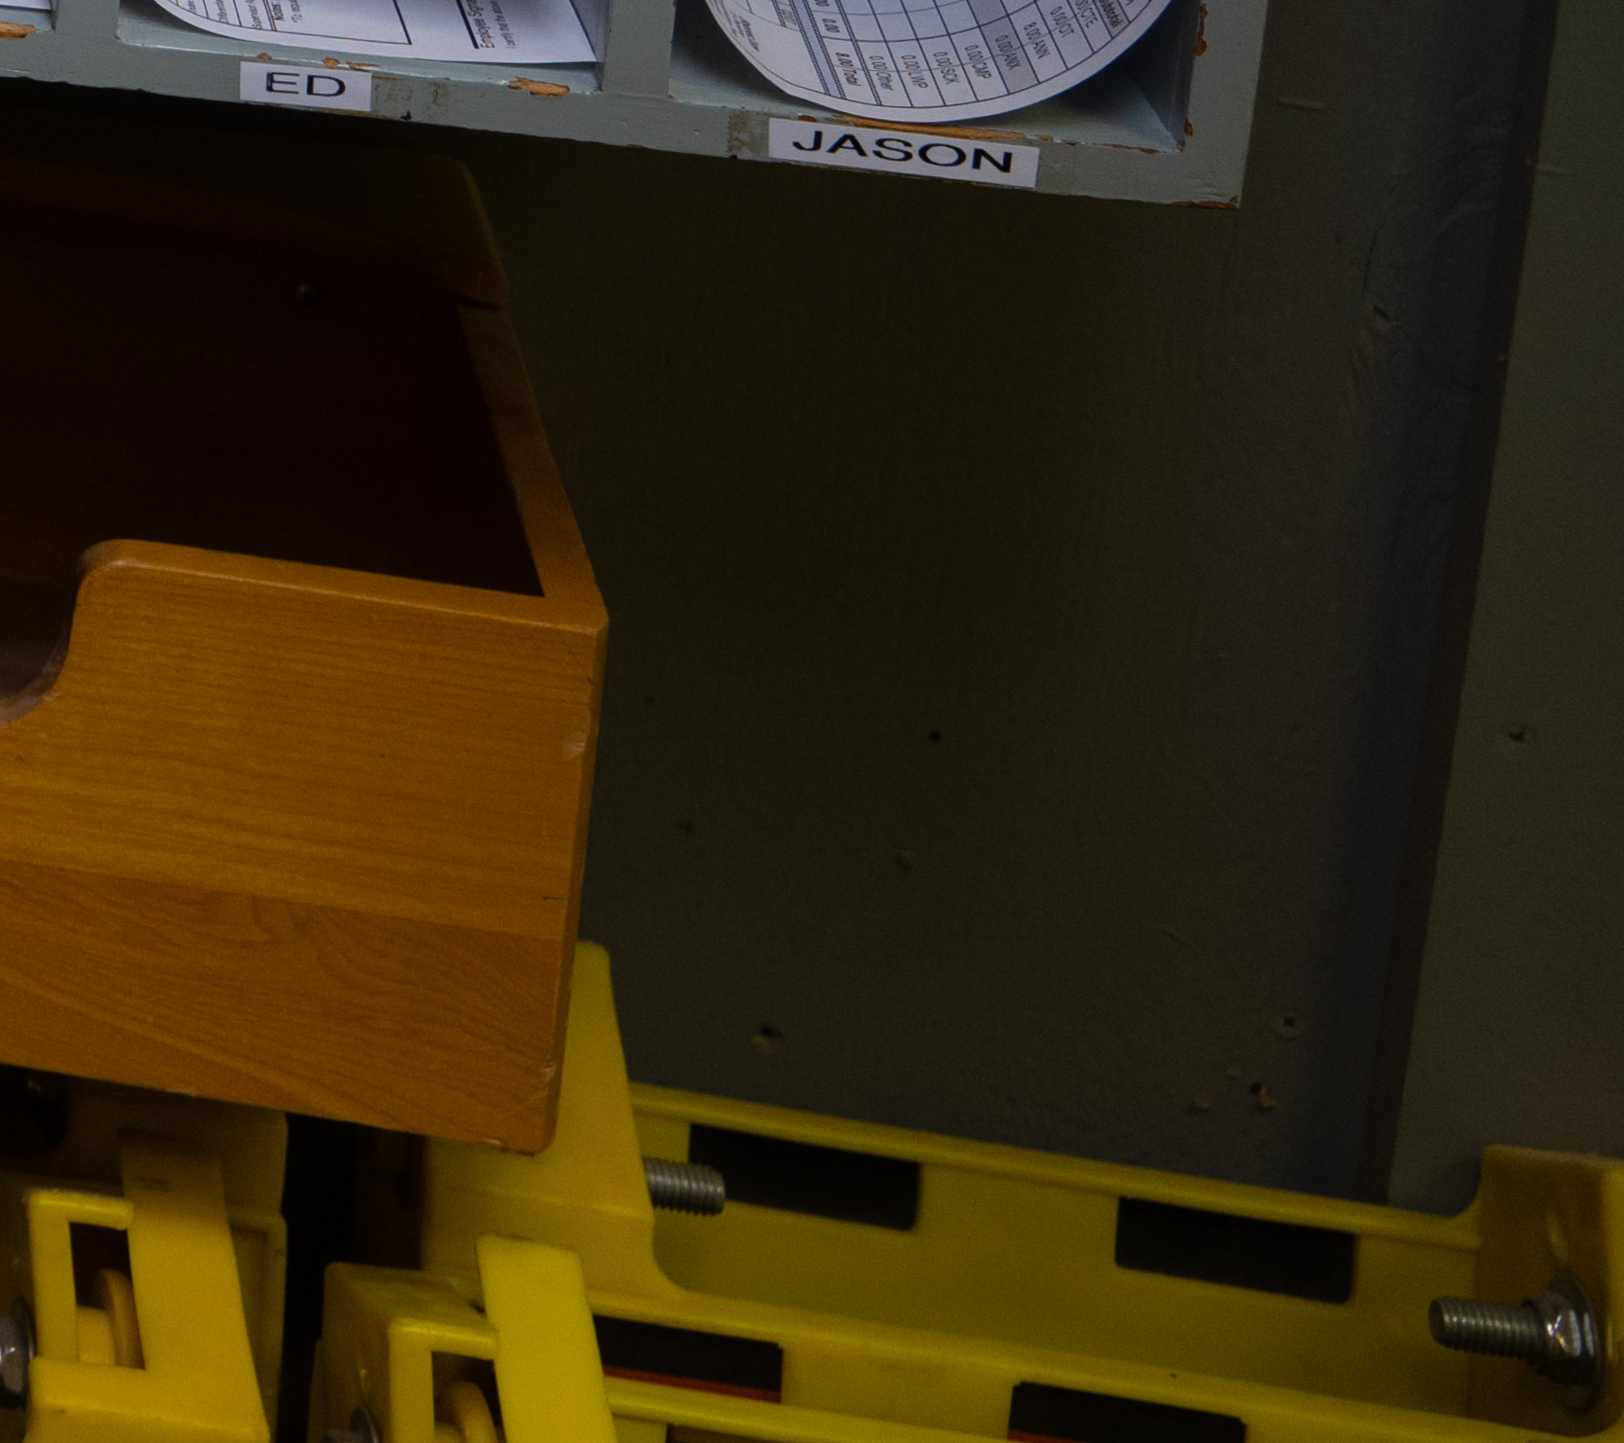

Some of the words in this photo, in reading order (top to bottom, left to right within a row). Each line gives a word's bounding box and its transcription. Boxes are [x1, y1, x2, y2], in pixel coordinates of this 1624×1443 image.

[269, 1, 285, 21] Notes:
[1048, 5, 1068, 26] 0.00
[1058, 23, 1074, 38] OT
[1078, 6, 1099, 29] CTE
[470, 18, 498, 48] Employee
[1022, 21, 1042, 41] 8.00
[963, 42, 984, 64] 0.00
[993, 33, 1013, 54] 0.00
[1030, 37, 1050, 59] ANN
[835, 48, 854, 70] 8.00
[868, 51, 887, 72] 0.00
[900, 51, 919, 71] 0.00
[932, 49, 951, 69] 0.00
[971, 59, 992, 82] CMP
[1001, 49, 1022, 72] ANX
[266, 71, 346, 98] ED
[841, 64, 862, 90] Total
[875, 67, 896, 93] Other
[907, 67, 928, 92] LWP
[939, 64, 959, 87] SCK
[791, 128, 1014, 174] JASON
